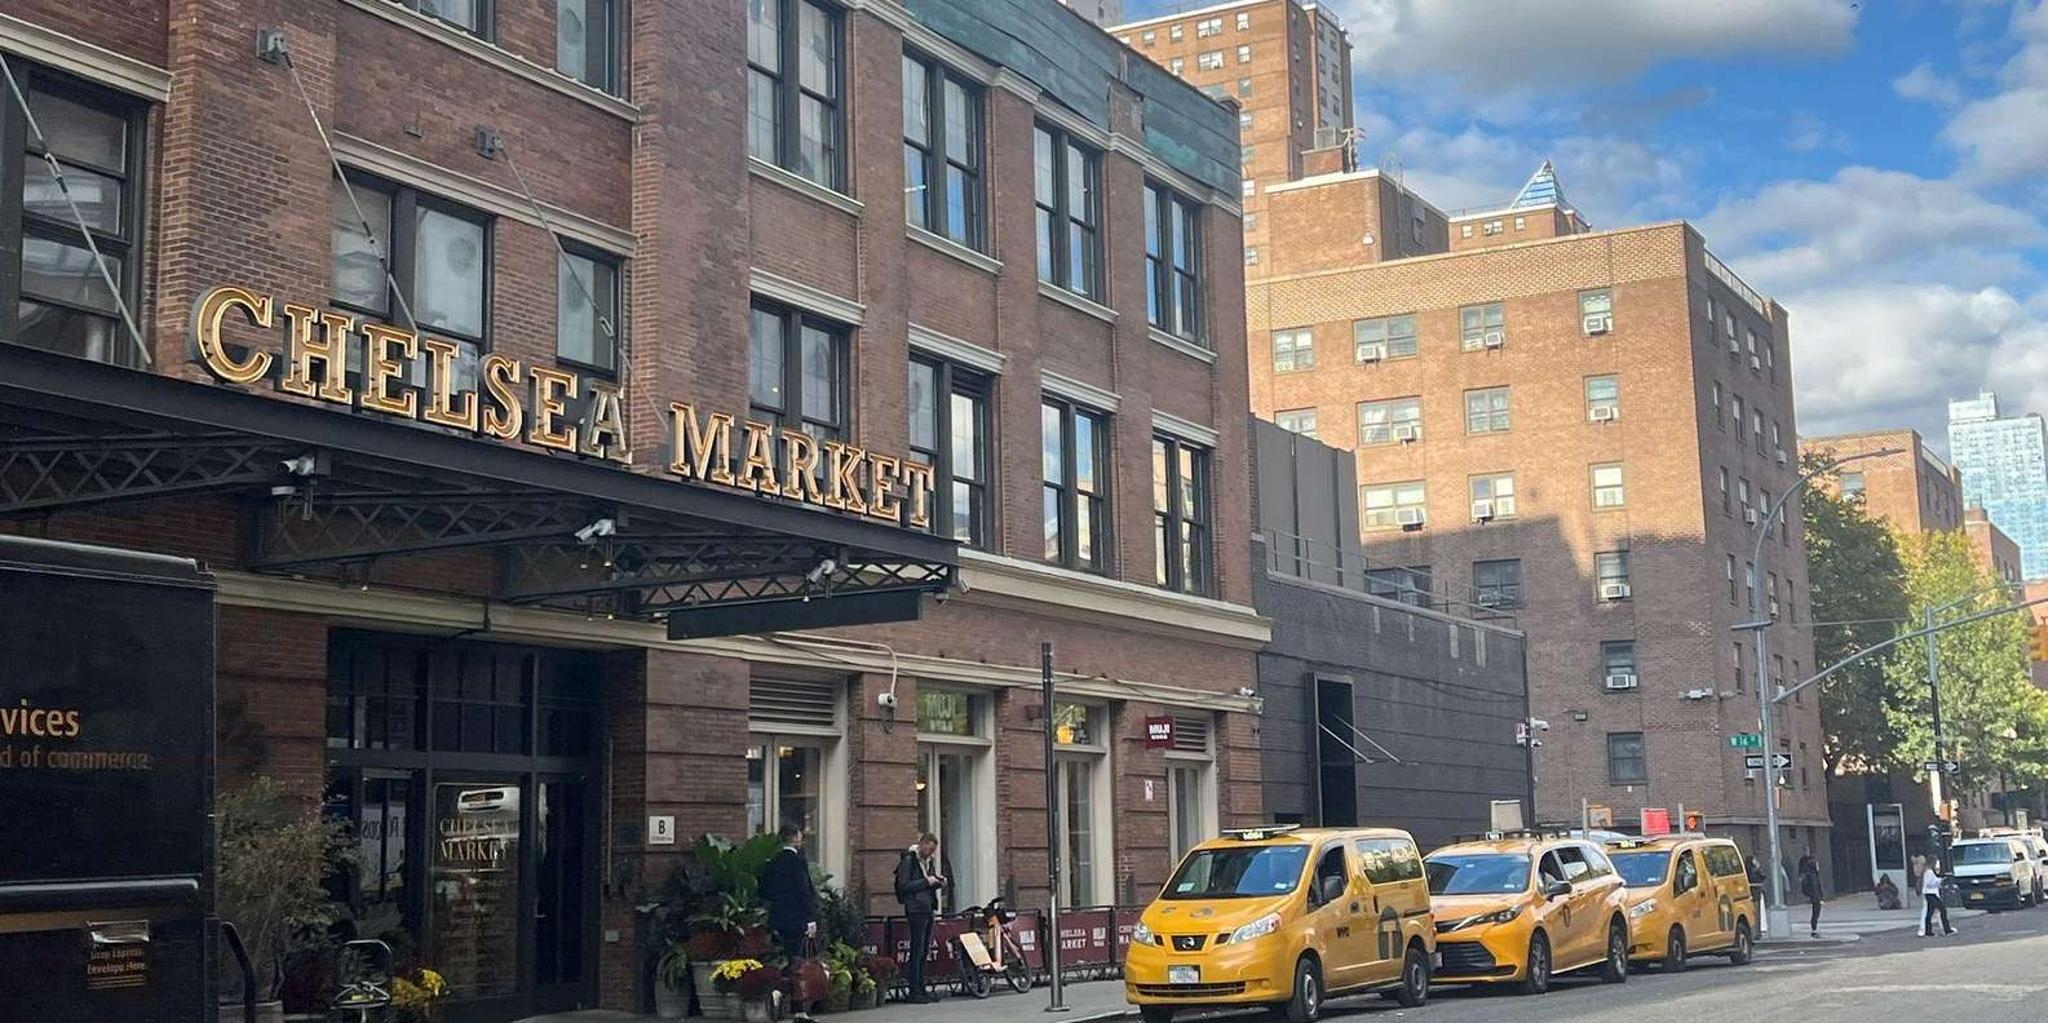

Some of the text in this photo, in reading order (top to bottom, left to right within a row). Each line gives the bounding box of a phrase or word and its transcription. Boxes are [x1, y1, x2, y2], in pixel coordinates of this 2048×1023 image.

[192, 284, 935, 529] CHELSEA MARKET
[0, 698, 80, 737] vices
[1149, 723, 1171, 734] MUJI
[20, 744, 42, 768] of
[47, 752, 152, 769] commerce
[658, 819, 666, 835] B
[441, 839, 511, 861] MARKET
[1060, 928, 1087, 938] HELSEA
[1061, 938, 1087, 949] ARKET
